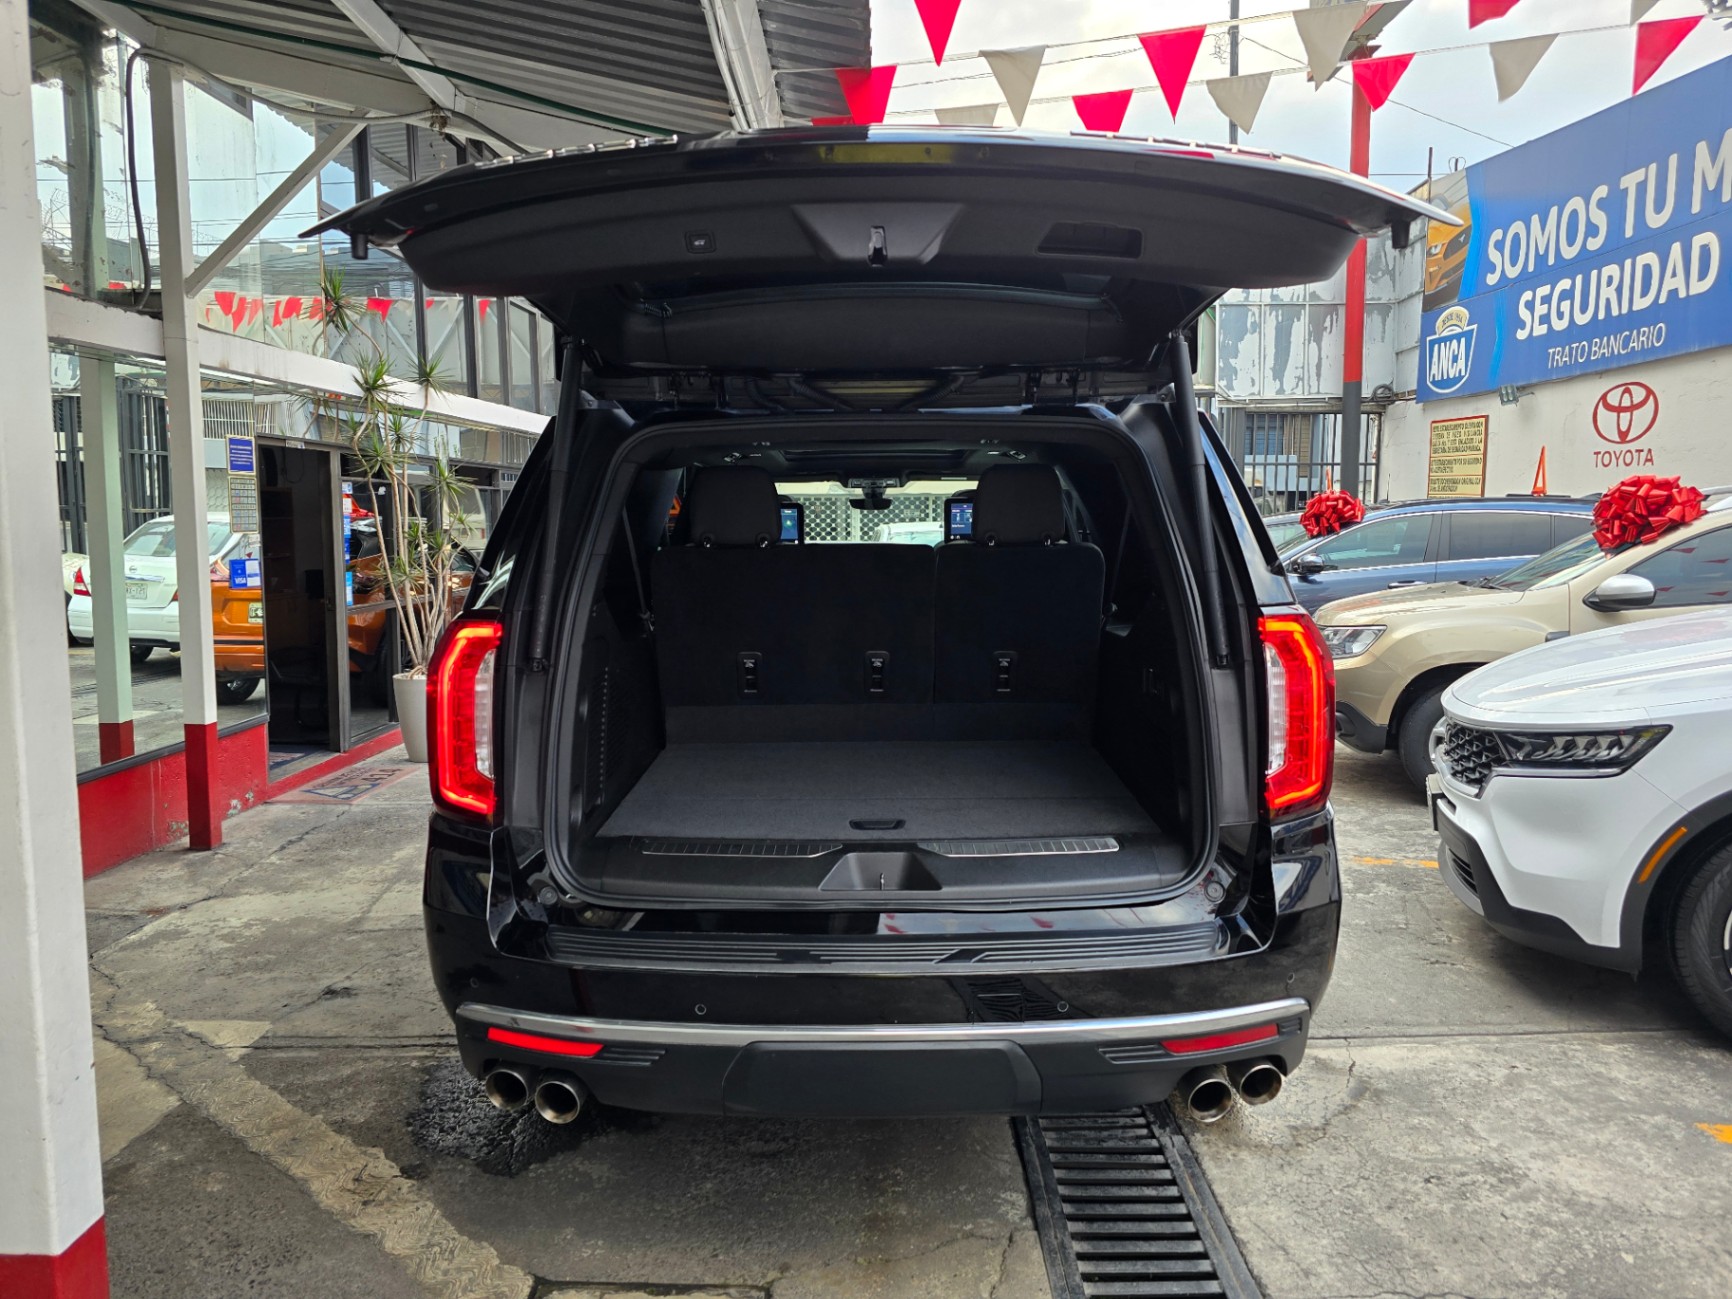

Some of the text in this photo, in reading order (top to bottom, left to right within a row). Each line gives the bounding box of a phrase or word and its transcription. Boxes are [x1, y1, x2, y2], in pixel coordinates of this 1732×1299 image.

[1486, 184, 1608, 286] SOMOS
[1619, 153, 1678, 239] TU
[1516, 231, 1720, 340] SEGURIDAD
[1429, 337, 1466, 382] ANCA
[1547, 322, 1666, 369] TRATO BANCARIO
[1593, 448, 1654, 468] TOYOTA
